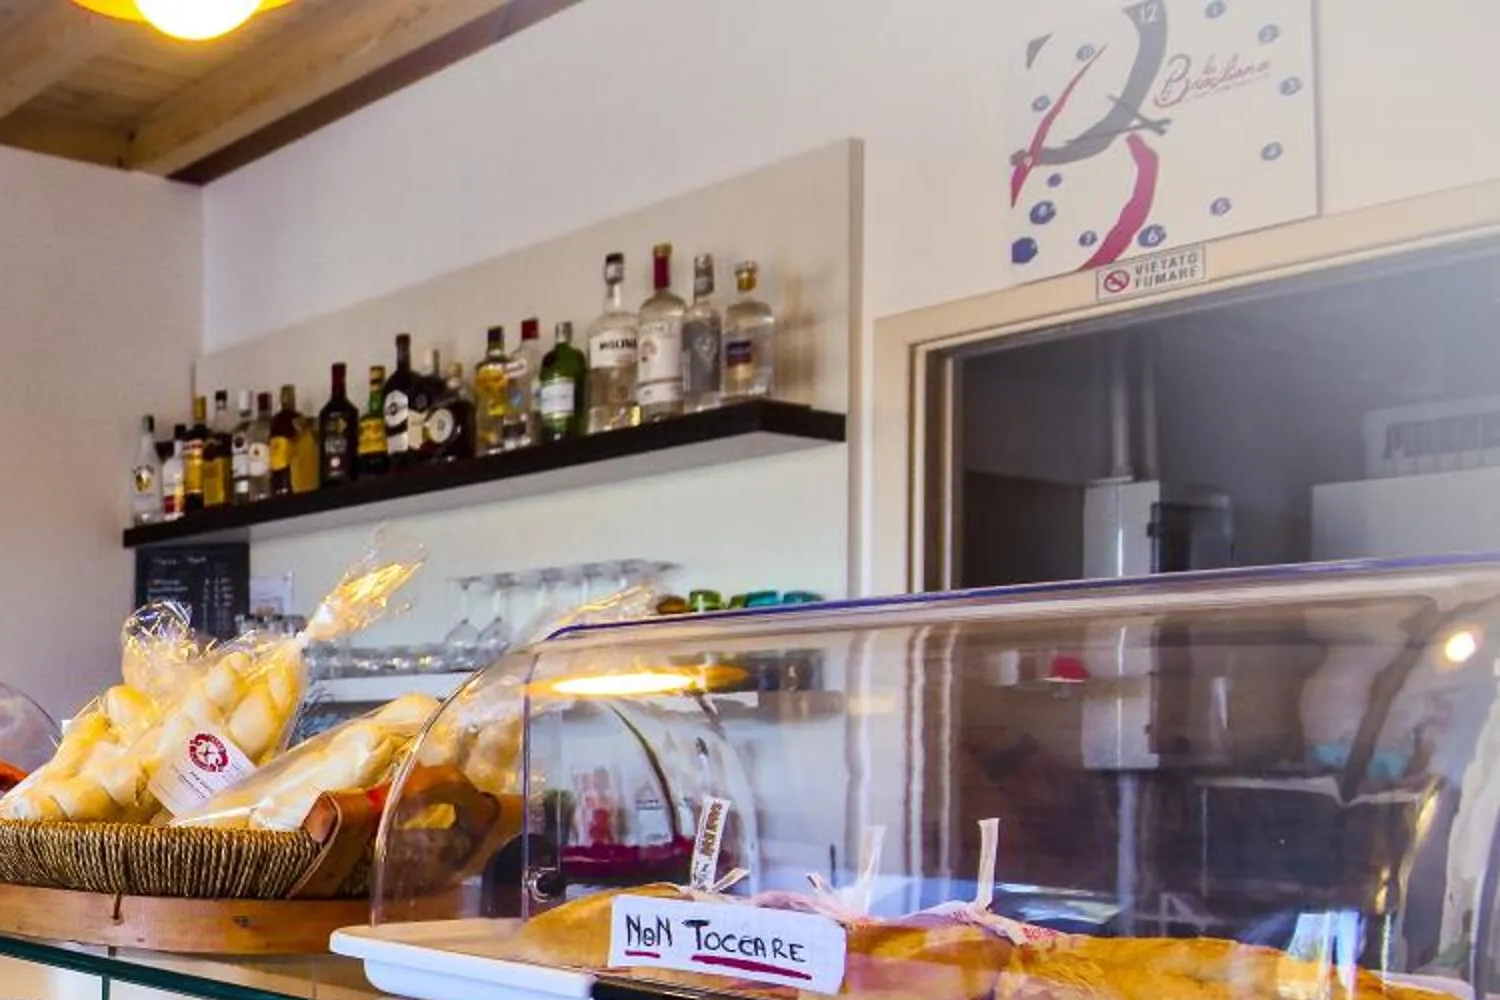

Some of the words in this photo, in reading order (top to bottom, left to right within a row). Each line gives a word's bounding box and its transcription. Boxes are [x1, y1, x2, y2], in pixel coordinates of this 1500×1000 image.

[1135, 252, 1198, 275] VIETATO
[1135, 265, 1199, 289] FUMARE
[682, 919, 807, 963] TOCCARE
